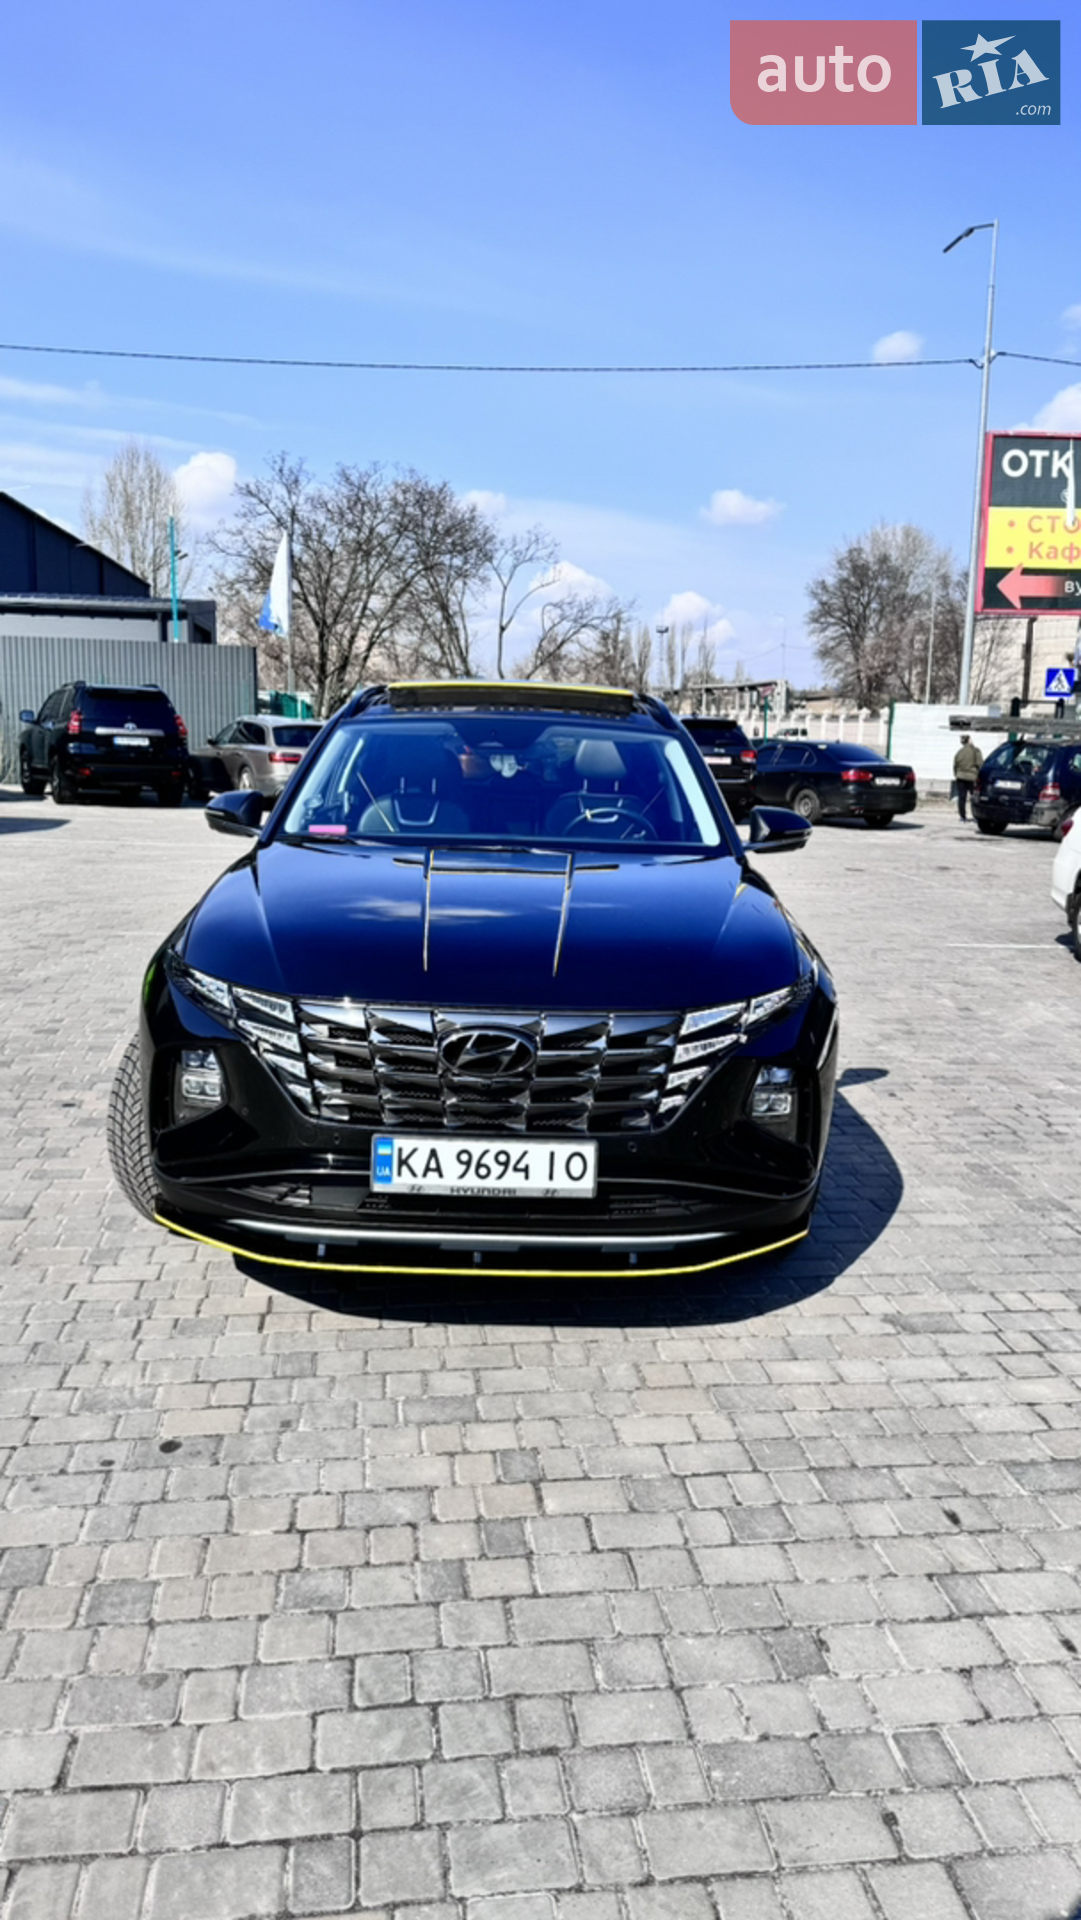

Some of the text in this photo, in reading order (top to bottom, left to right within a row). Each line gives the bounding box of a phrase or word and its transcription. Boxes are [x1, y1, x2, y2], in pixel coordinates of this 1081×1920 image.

[1001, 449, 1073, 478] ОТК
[376, 1166, 391, 1177] UA
[397, 1147, 444, 1179] KA
[455, 1149, 530, 1180] 9694
